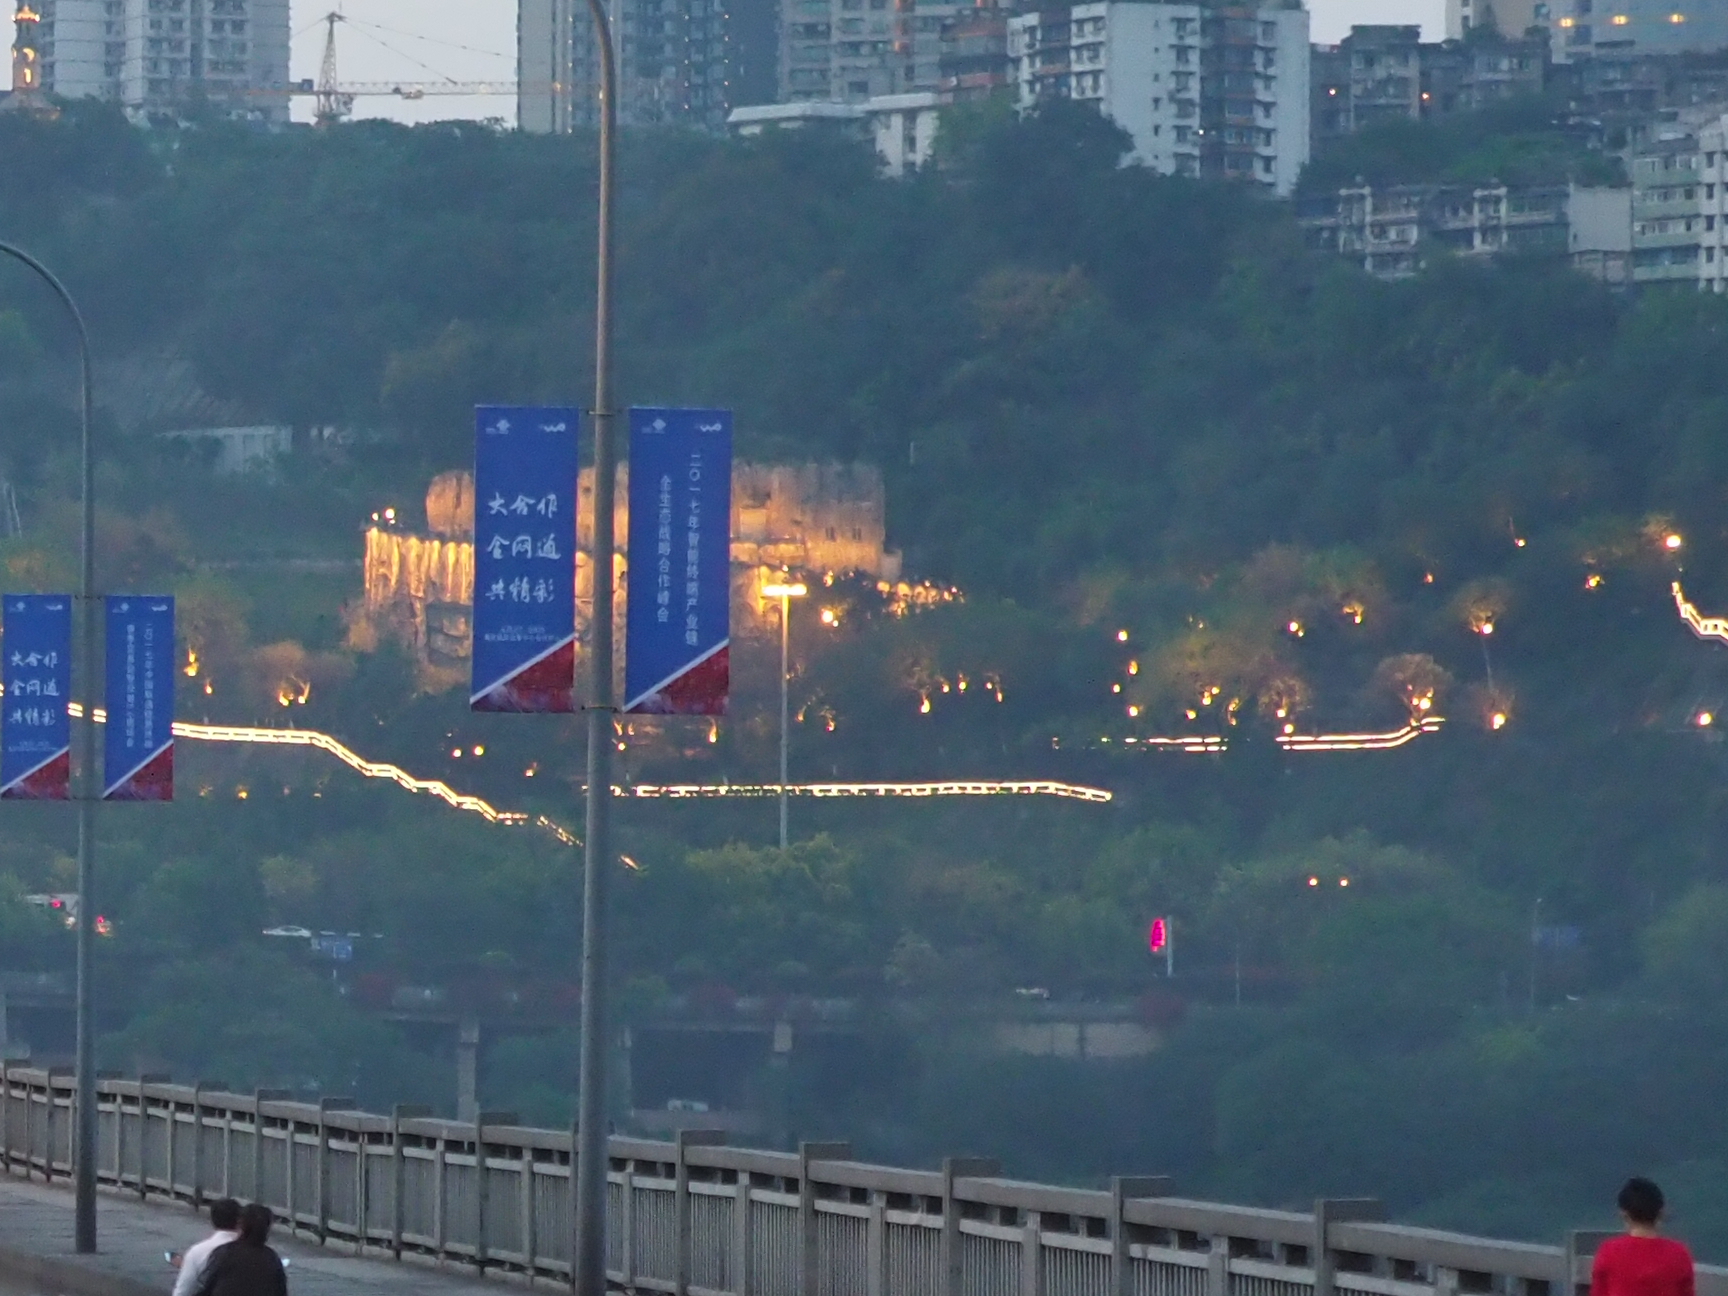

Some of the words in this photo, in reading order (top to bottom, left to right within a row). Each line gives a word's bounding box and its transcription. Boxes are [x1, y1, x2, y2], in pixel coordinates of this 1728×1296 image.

[488, 492, 557, 518] 大合作
[486, 533, 561, 559] 全网通
[486, 577, 553, 603] 共精彩
